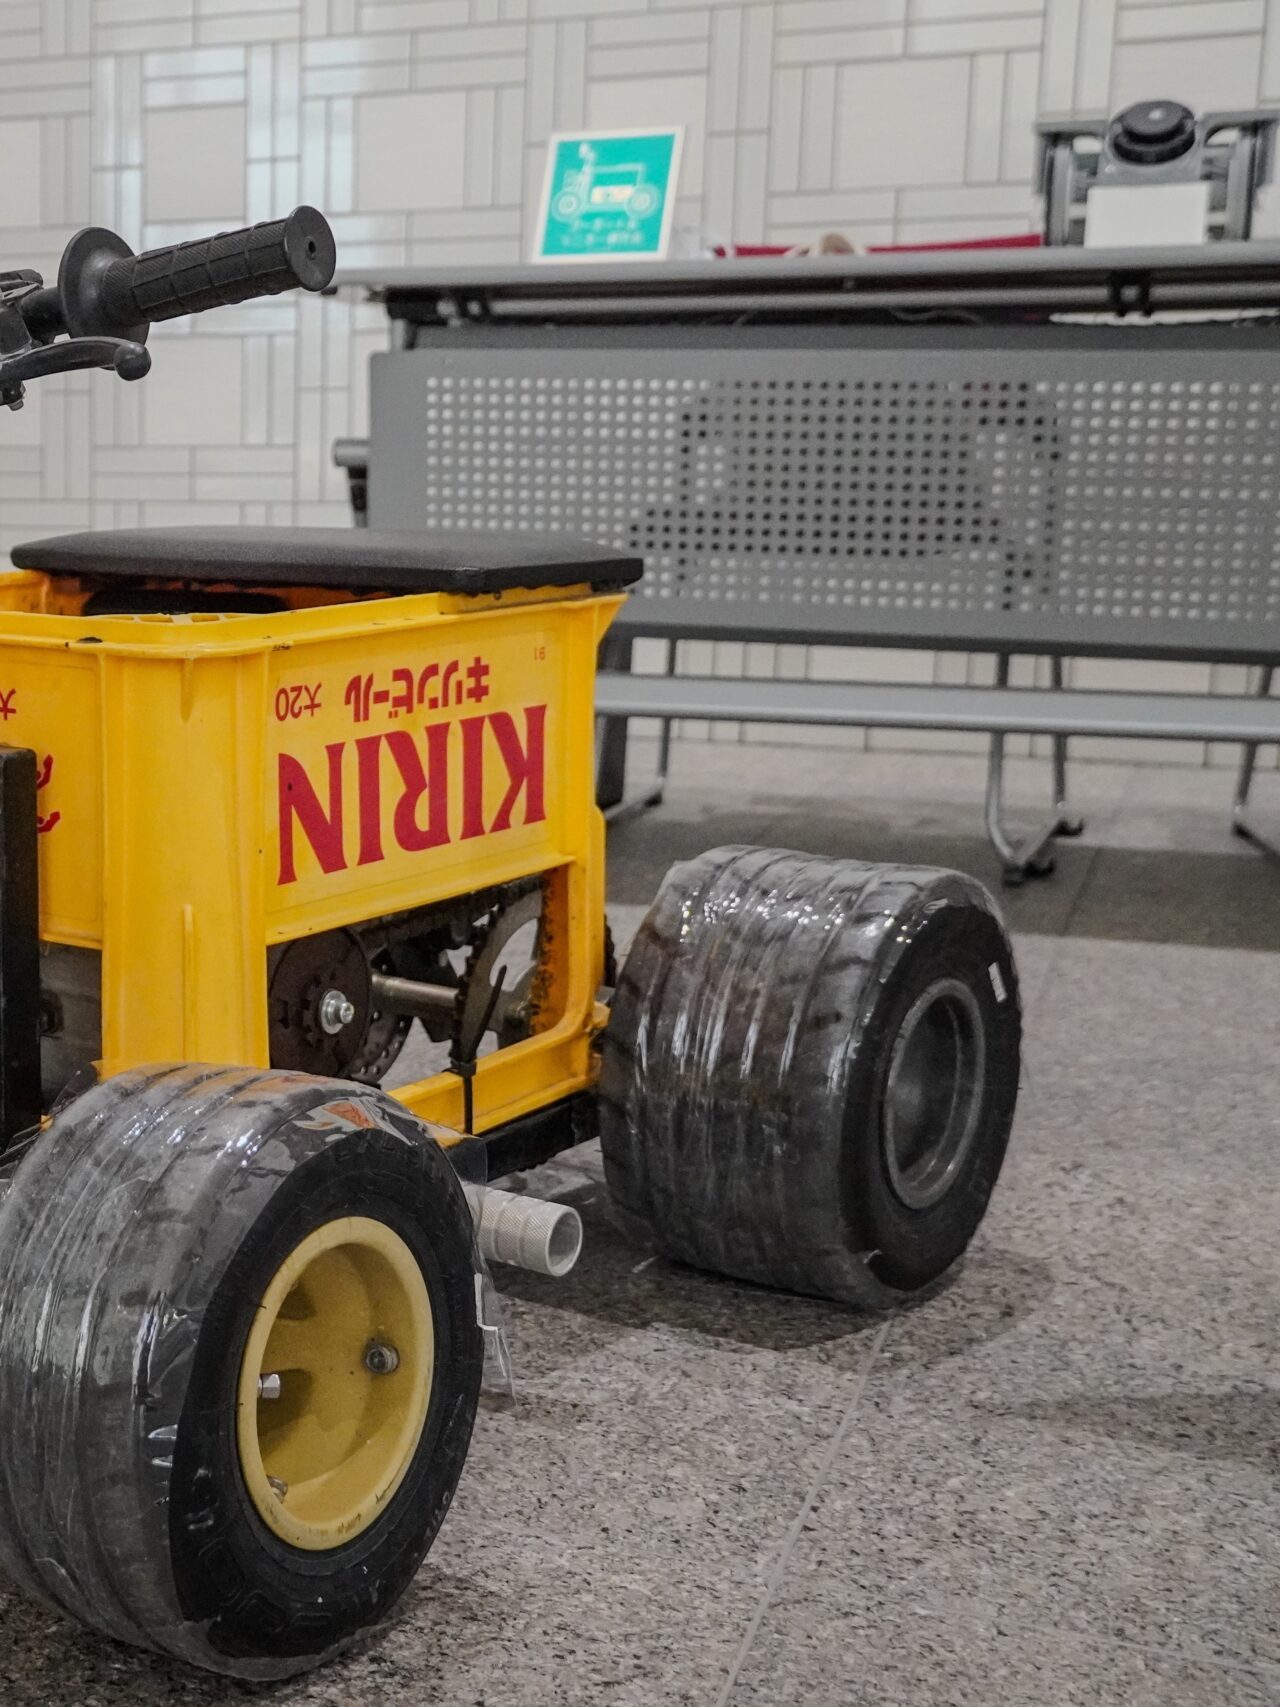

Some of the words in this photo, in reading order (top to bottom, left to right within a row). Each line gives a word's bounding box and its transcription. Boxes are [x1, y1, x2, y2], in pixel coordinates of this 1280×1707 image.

[275, 682, 322, 722] 大20
[344, 656, 490, 723] キリンビール
[277, 704, 547, 886] KIRIN
